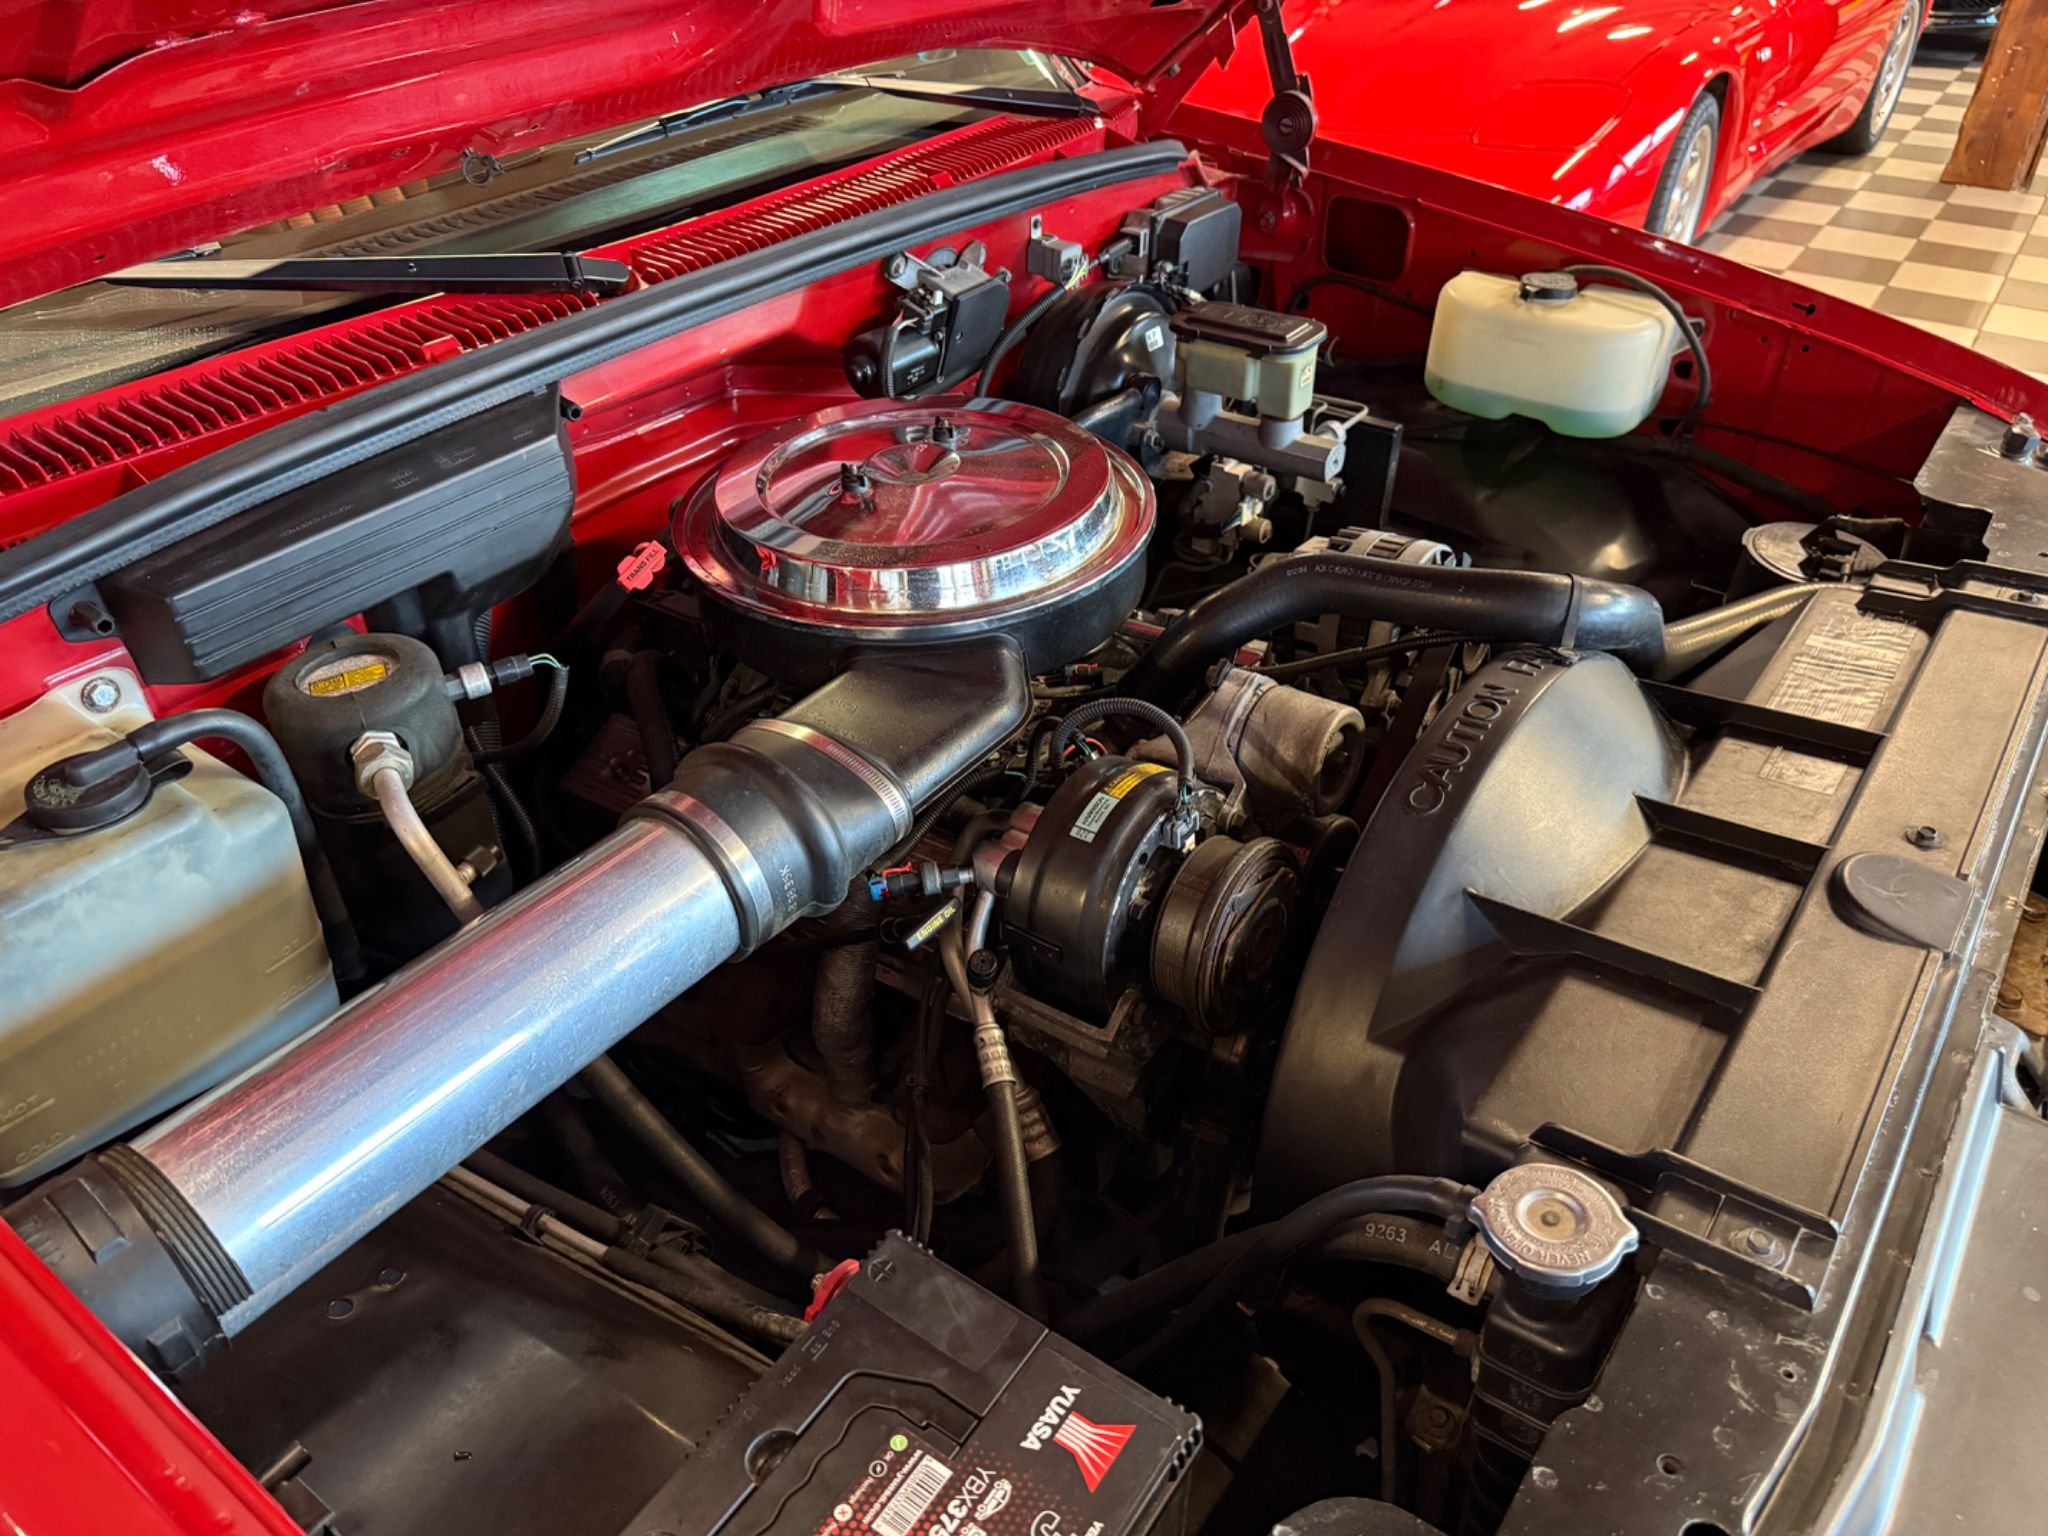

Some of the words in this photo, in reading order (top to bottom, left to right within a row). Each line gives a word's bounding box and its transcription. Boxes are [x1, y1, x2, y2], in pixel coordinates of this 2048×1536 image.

[626, 560, 648, 582] TRANS
[645, 548, 660, 562] FILL
[1409, 683, 1520, 817] CAUTION
[917, 914, 945, 941] ENGINE
[944, 904, 957, 919] OIL
[15, 1131, 63, 1164] COLD
[1364, 1222, 1408, 1244] 9263
[1500, 1226, 1535, 1261] OPEN
[1536, 1248, 1592, 1268] NEVER
[1018, 1384, 1083, 1451] YUASA
[882, 1450, 896, 1462] OK
[848, 1476, 875, 1505] Recharge
[861, 1448, 924, 1525] www.yuasa.com
